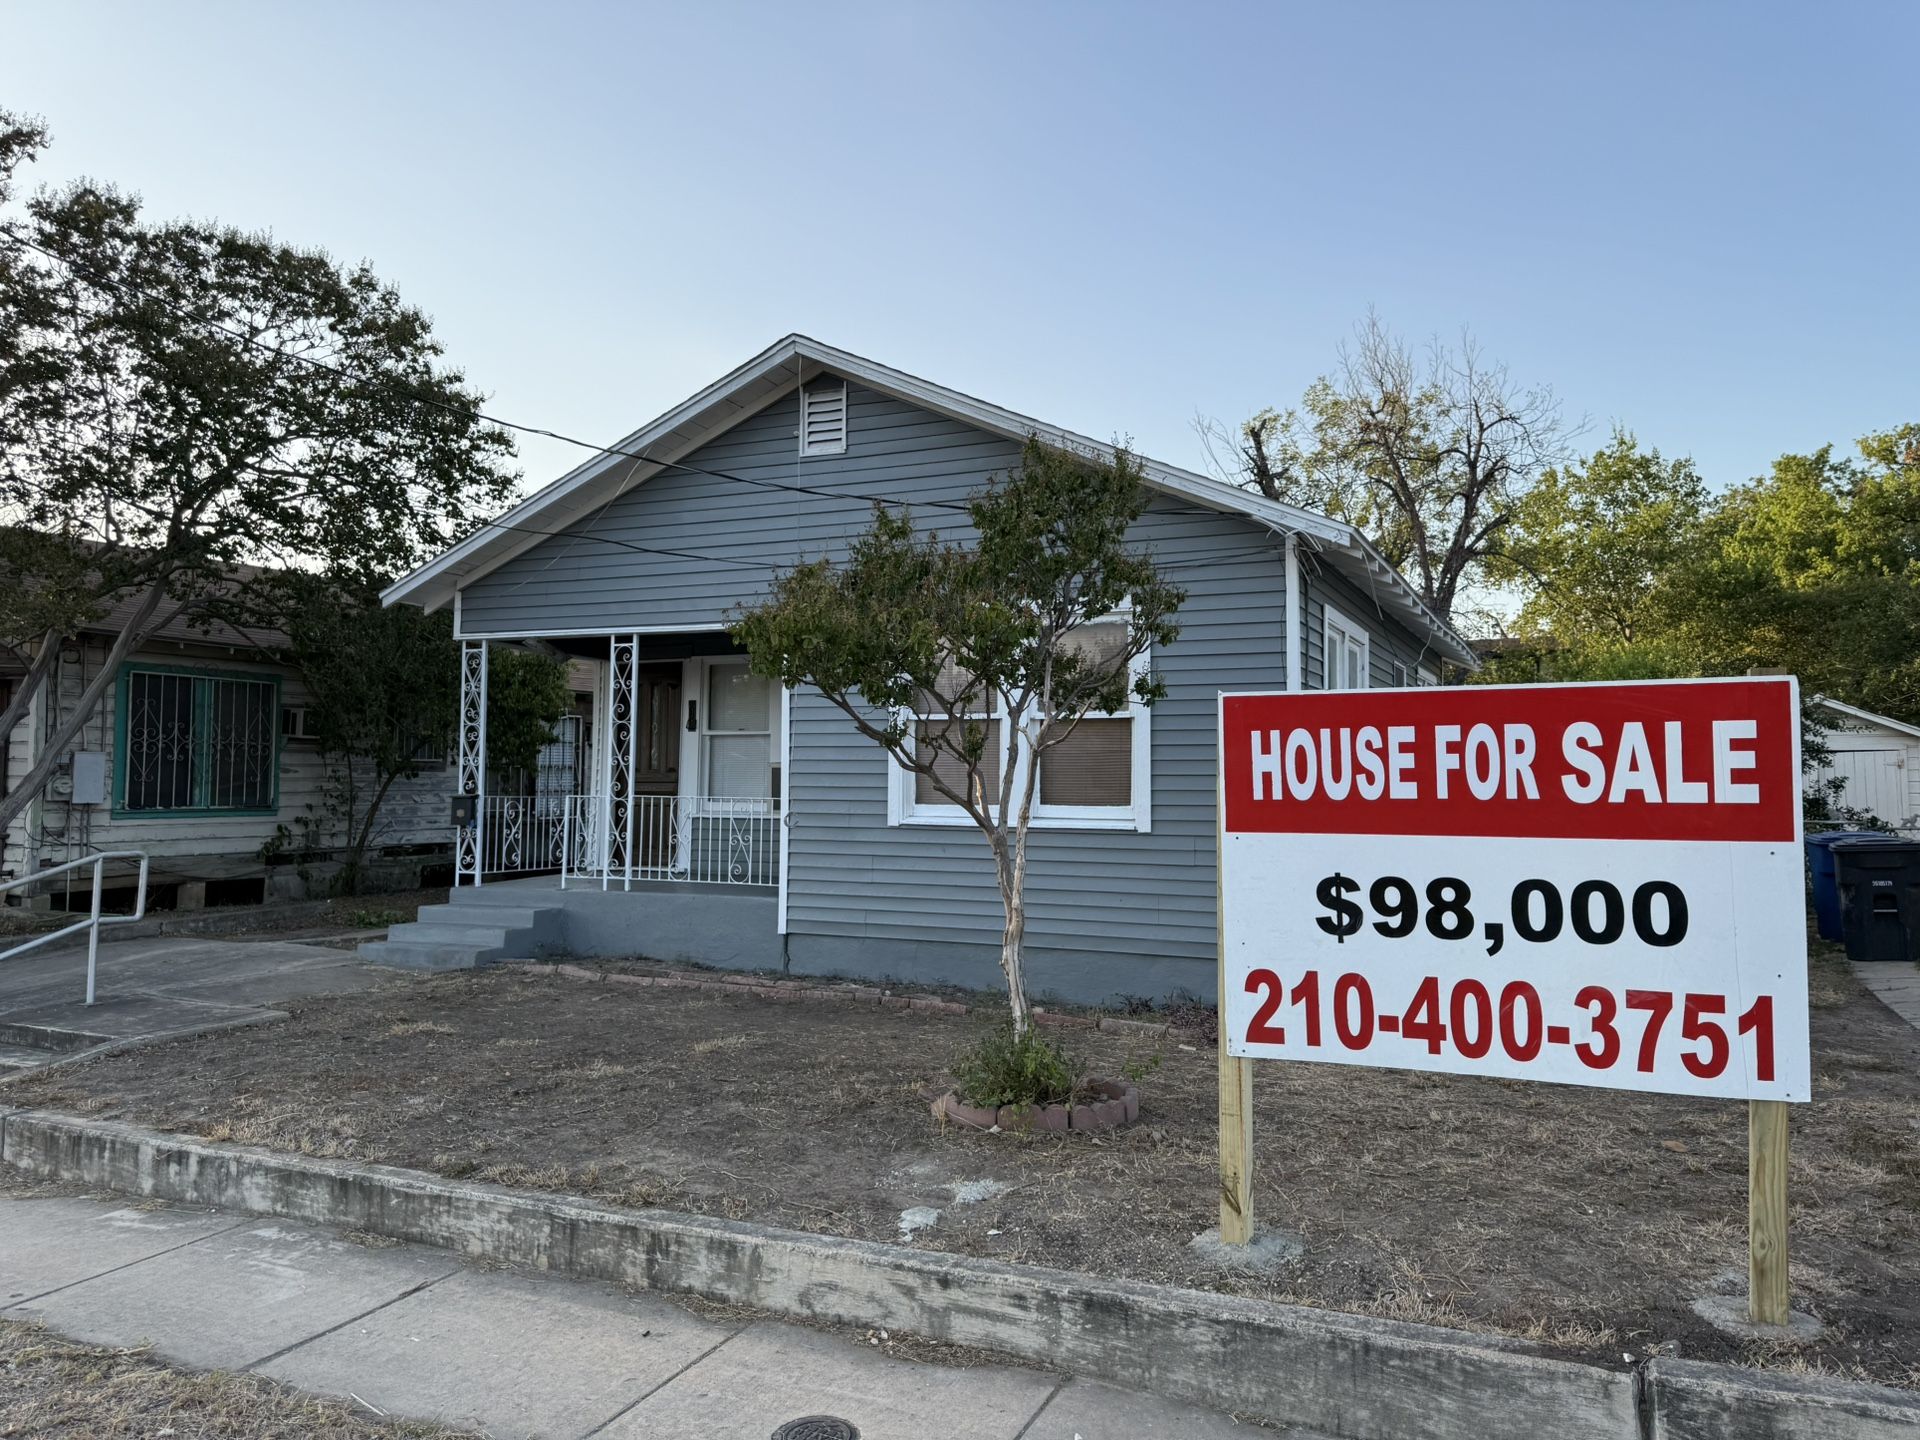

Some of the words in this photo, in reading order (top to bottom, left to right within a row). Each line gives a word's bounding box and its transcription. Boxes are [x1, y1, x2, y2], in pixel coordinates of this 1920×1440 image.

[1251, 725, 1418, 801] HOUSE
[1435, 723, 1540, 801] FOR
[1561, 720, 1760, 804] SALE
[1315, 872, 1689, 957] $98,000
[1244, 969, 1774, 1081] 210-400-3751
